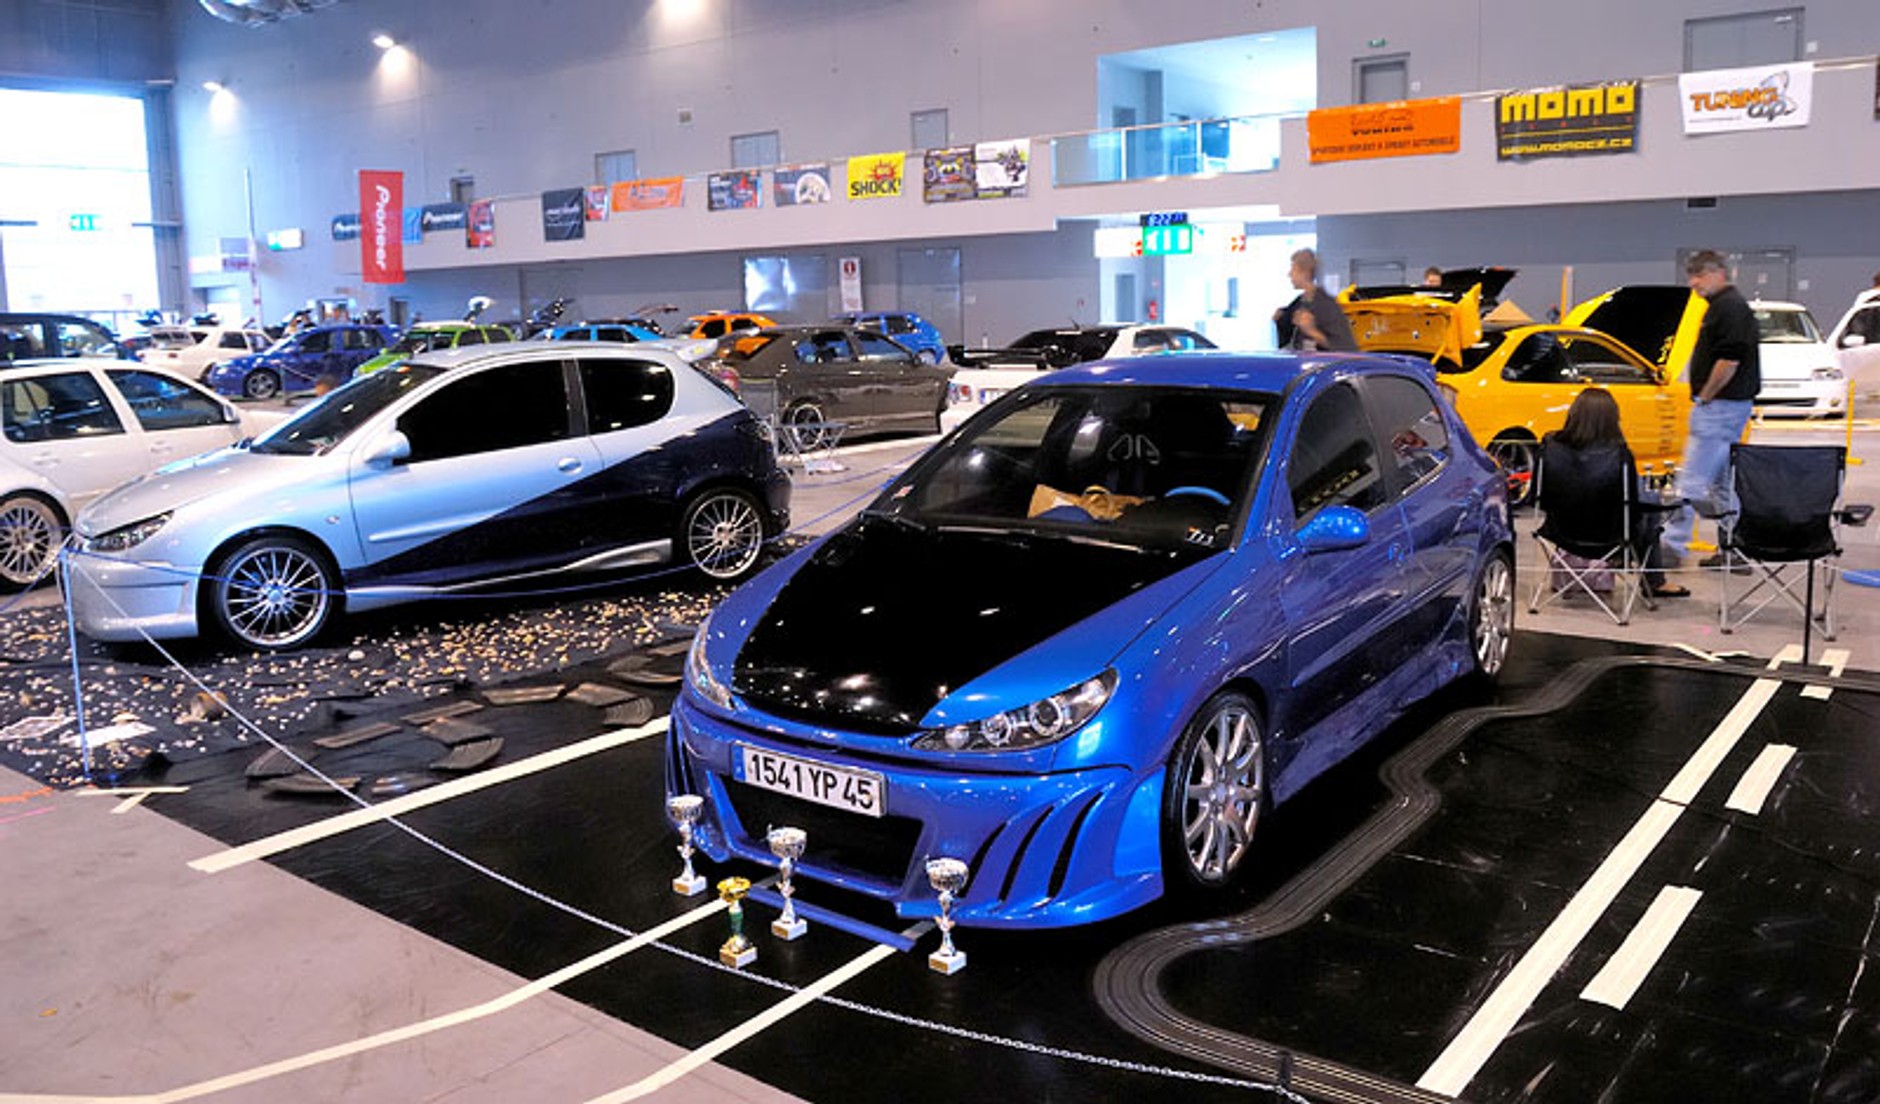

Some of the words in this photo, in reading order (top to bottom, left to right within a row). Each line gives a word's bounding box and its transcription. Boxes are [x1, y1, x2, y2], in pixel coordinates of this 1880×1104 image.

[376, 185, 391, 271] Pioneer
[752, 754, 802, 793] 1541
[808, 768, 838, 799] YP
[843, 776, 874, 810] 45
